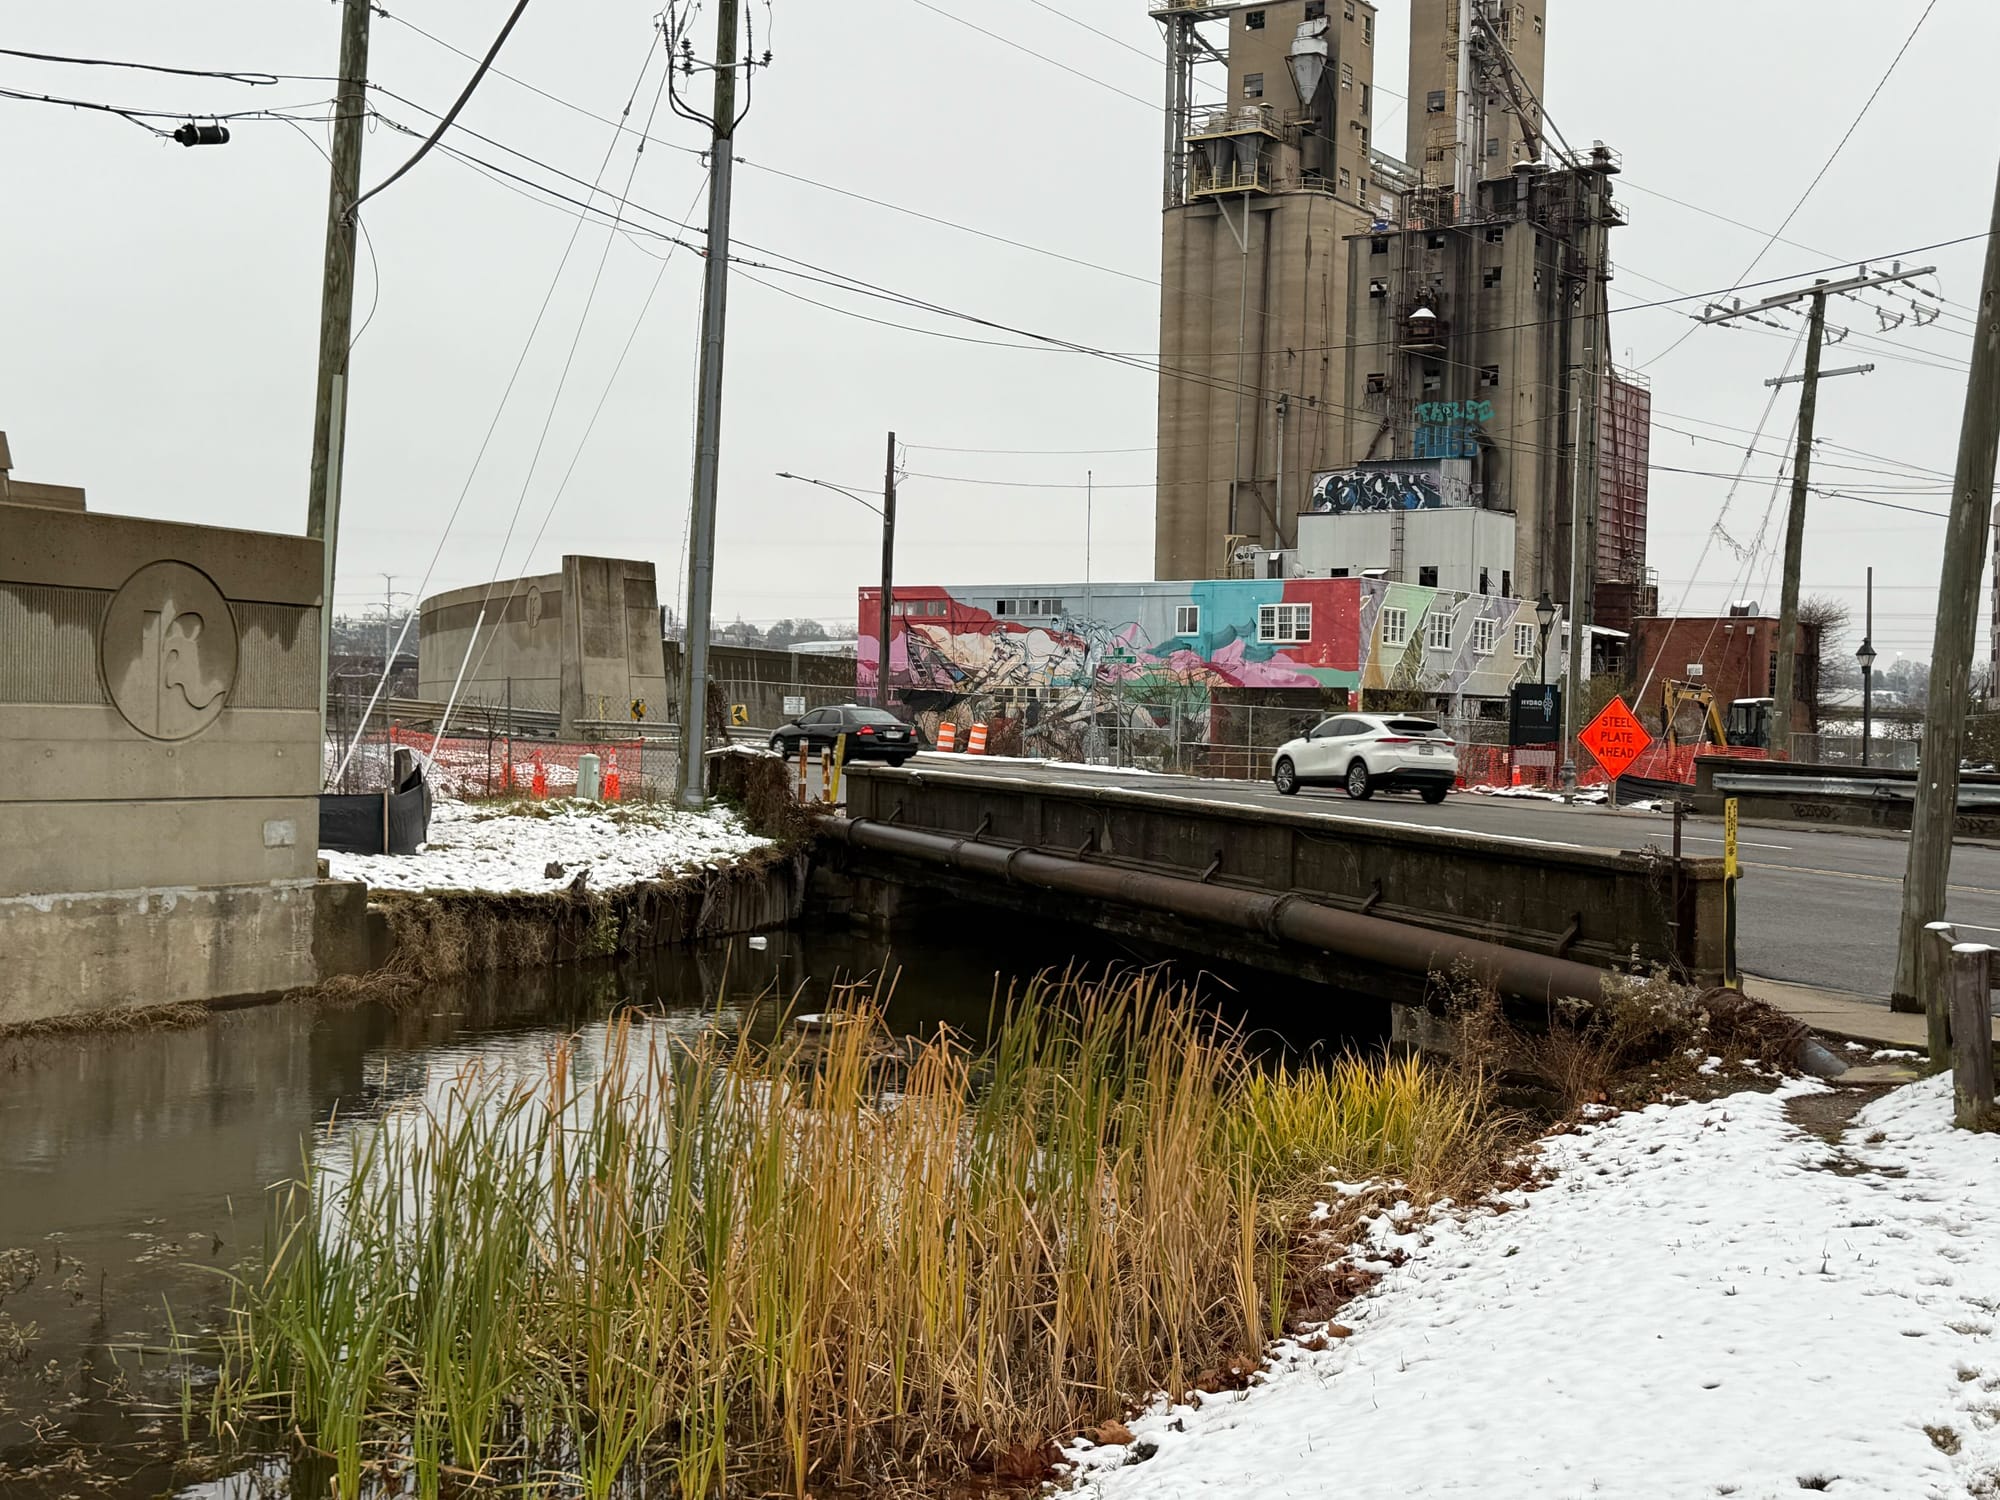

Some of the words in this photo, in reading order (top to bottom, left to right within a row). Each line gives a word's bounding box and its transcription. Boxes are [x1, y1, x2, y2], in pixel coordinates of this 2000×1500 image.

[1601, 716, 1633, 728] STEEL
[1600, 731, 1633, 744] PLATE
[1599, 746, 1634, 759] AHEAD
